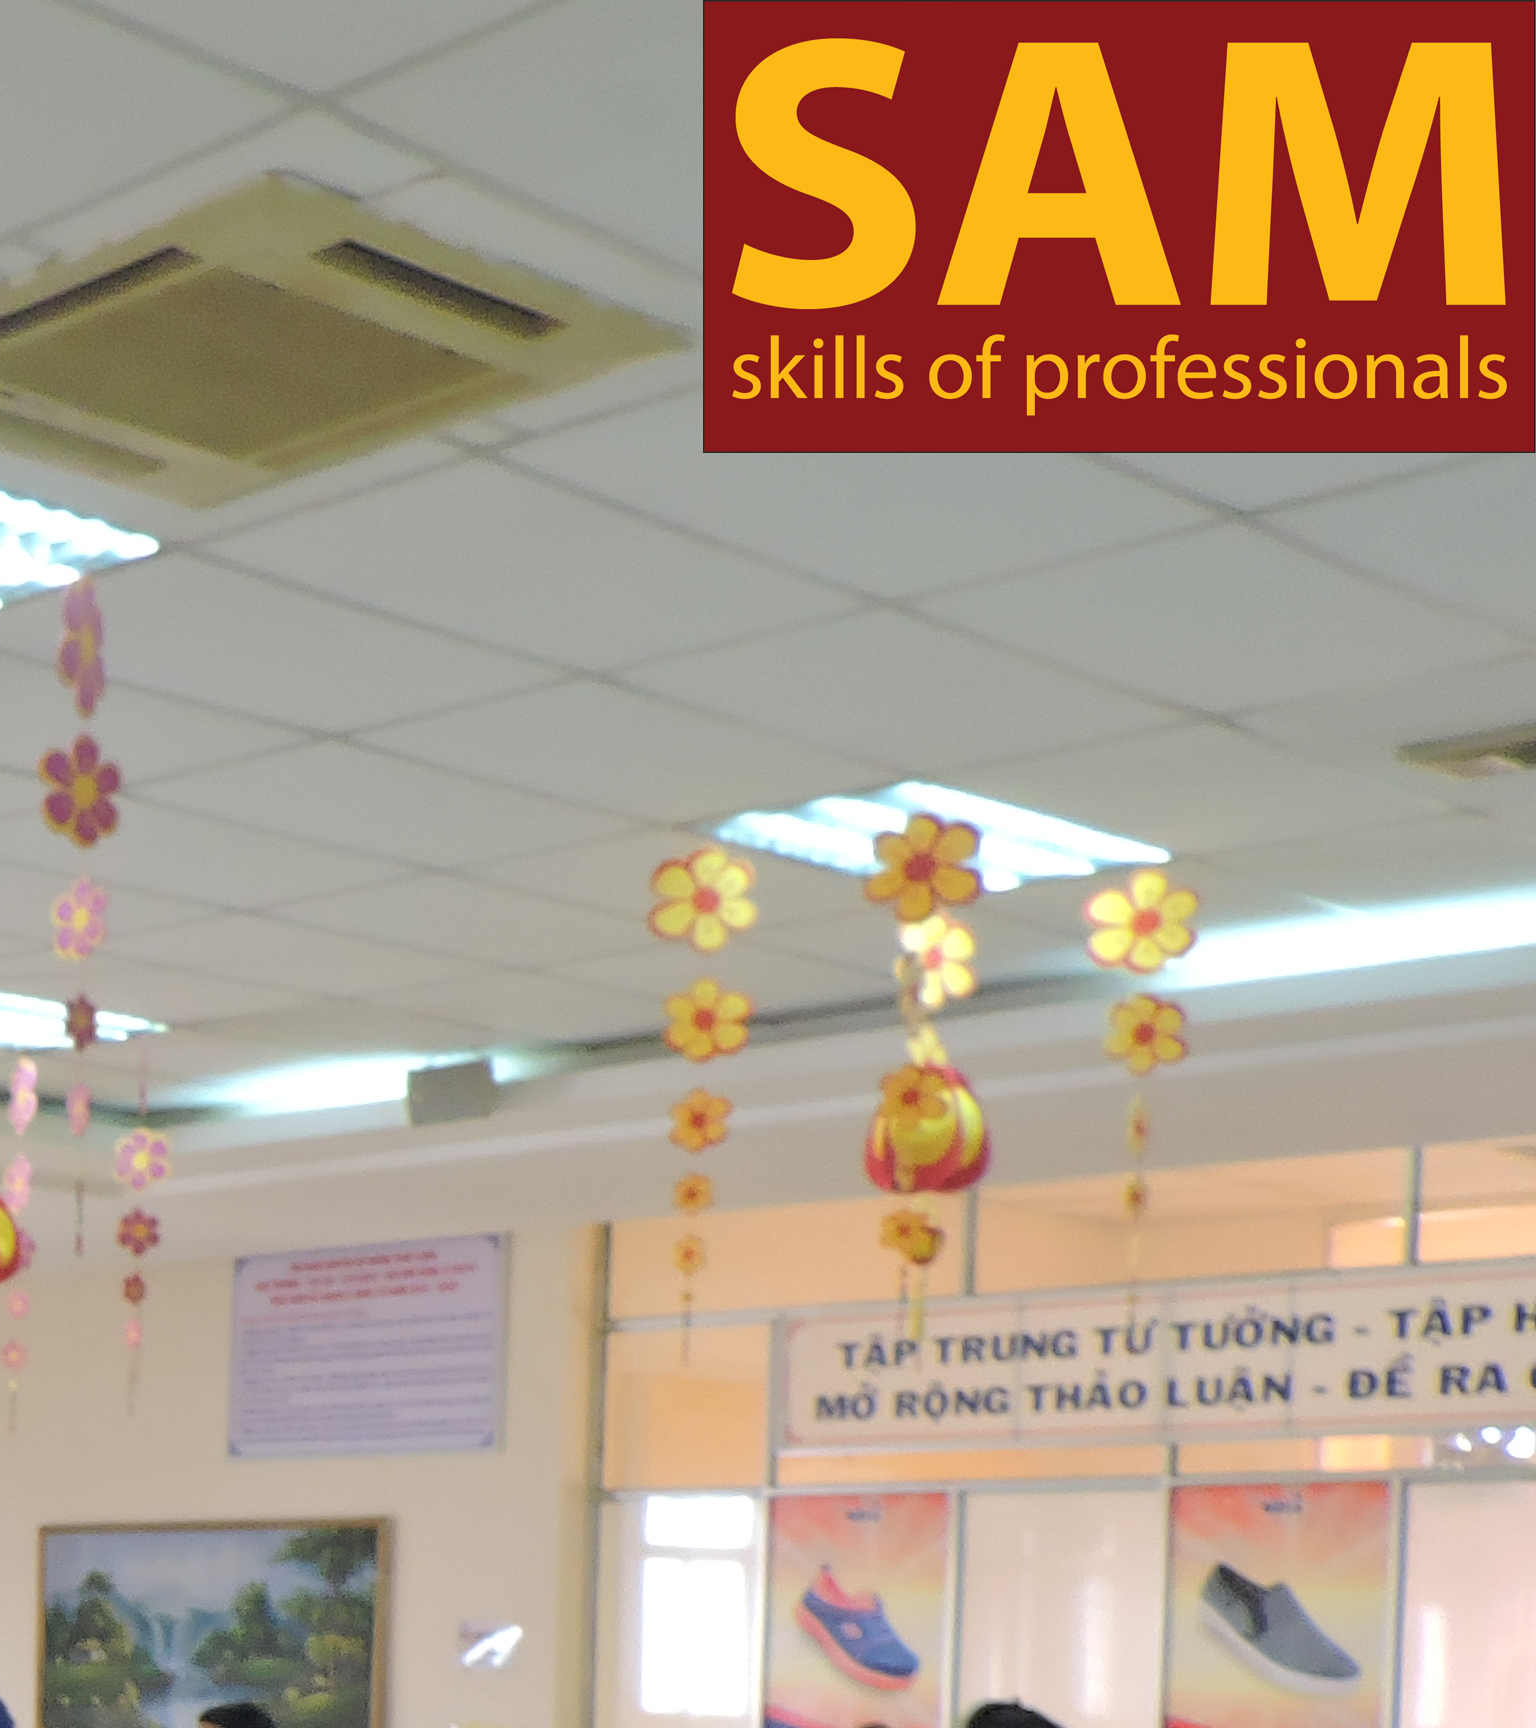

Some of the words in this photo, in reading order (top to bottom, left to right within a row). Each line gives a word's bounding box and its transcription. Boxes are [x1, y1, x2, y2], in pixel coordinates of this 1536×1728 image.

[933, 1329, 1077, 1365] TRUNG
[1388, 1295, 1493, 1347] TẬP
[1026, 1367, 1149, 1413] THẢO
[1166, 1365, 1294, 1411] LUẬN
[1439, 1361, 1509, 1396] RA
